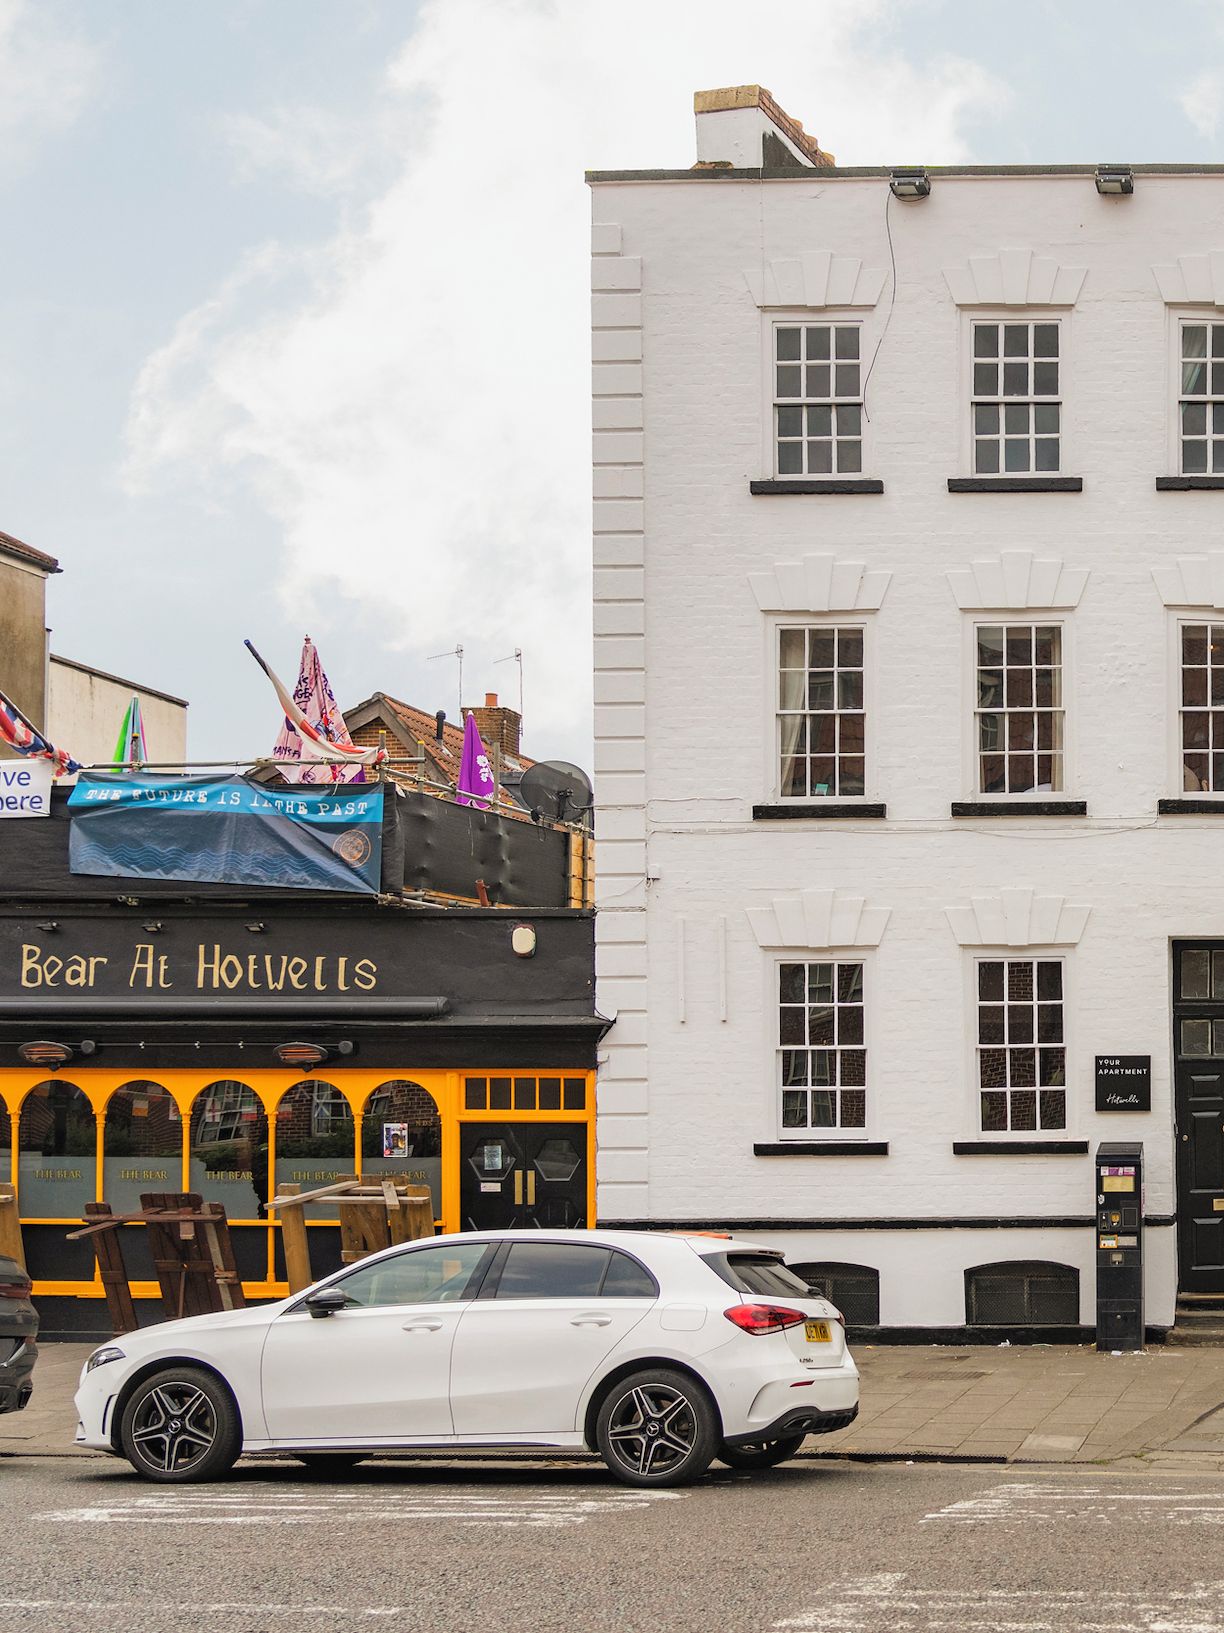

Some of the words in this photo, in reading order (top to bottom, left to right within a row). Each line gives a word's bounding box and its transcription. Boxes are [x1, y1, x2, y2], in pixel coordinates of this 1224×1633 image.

[85, 788, 123, 801] THE
[131, 788, 208, 803] FUTURE
[217, 791, 241, 805] IS
[274, 800, 308, 815] THE
[317, 802, 368, 816] PAST
[21, 944, 108, 988] Bear
[129, 944, 173, 988] At
[35, 1170, 55, 1179] THE
[57, 1170, 81, 1179] BEAR
[120, 1170, 140, 1179] THE
[143, 1170, 168, 1179] BEAR
[205, 1171, 226, 1180] THE
[228, 1171, 254, 1180] BEAR
